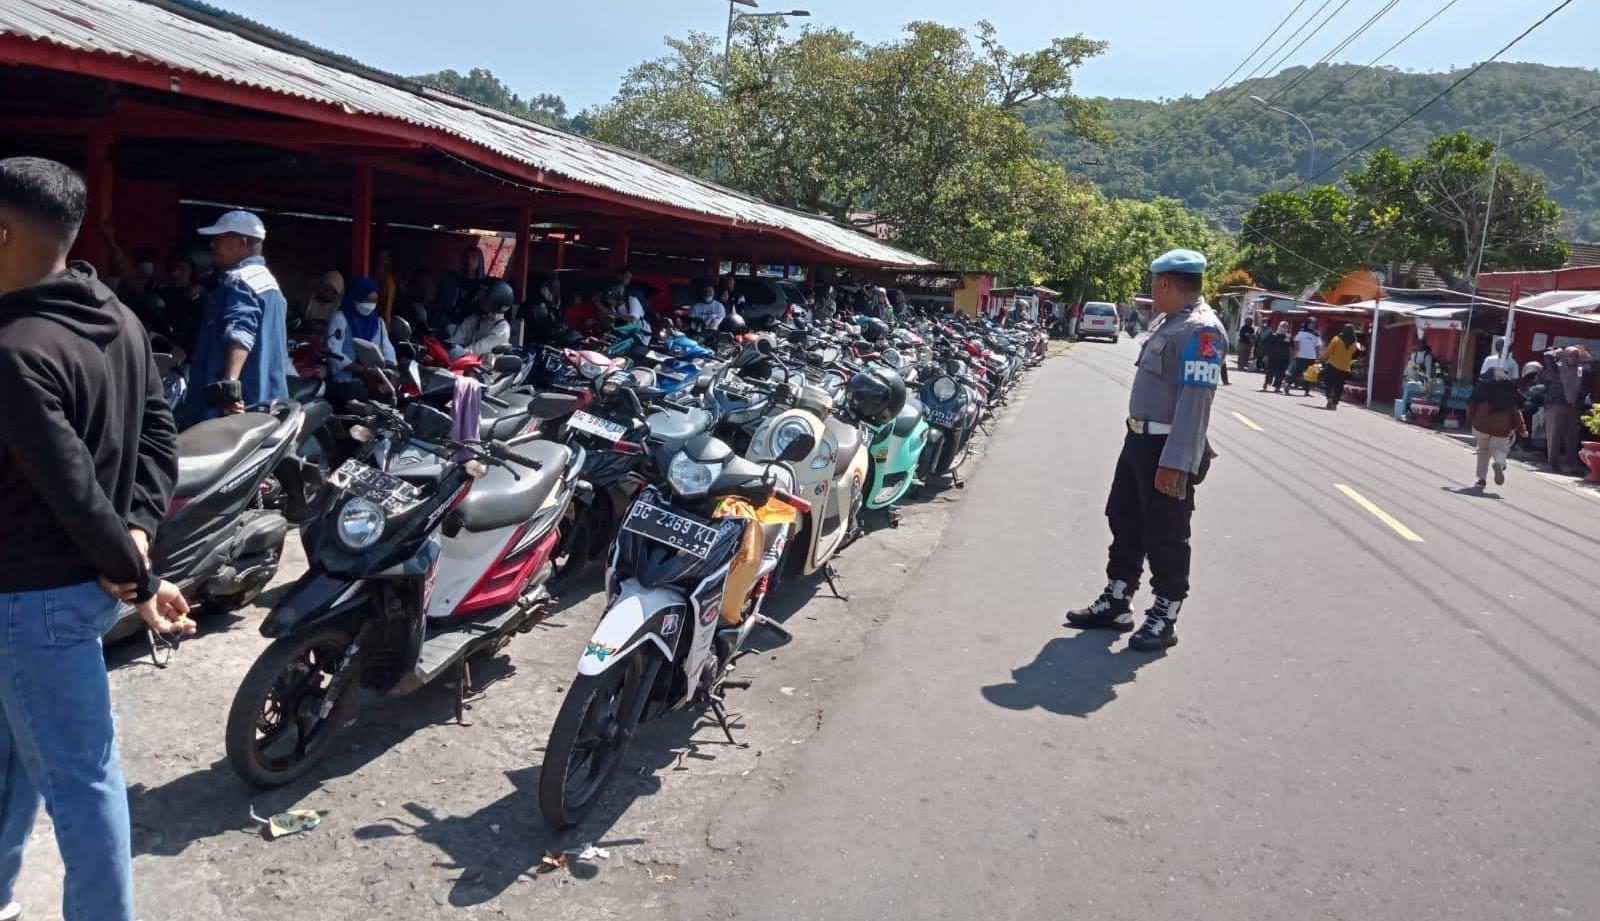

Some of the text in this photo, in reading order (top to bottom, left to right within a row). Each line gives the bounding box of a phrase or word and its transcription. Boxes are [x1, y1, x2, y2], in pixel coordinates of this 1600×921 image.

[632, 503, 652, 519] DG
[656, 513, 693, 534] 2369
[694, 526, 714, 545] KL
